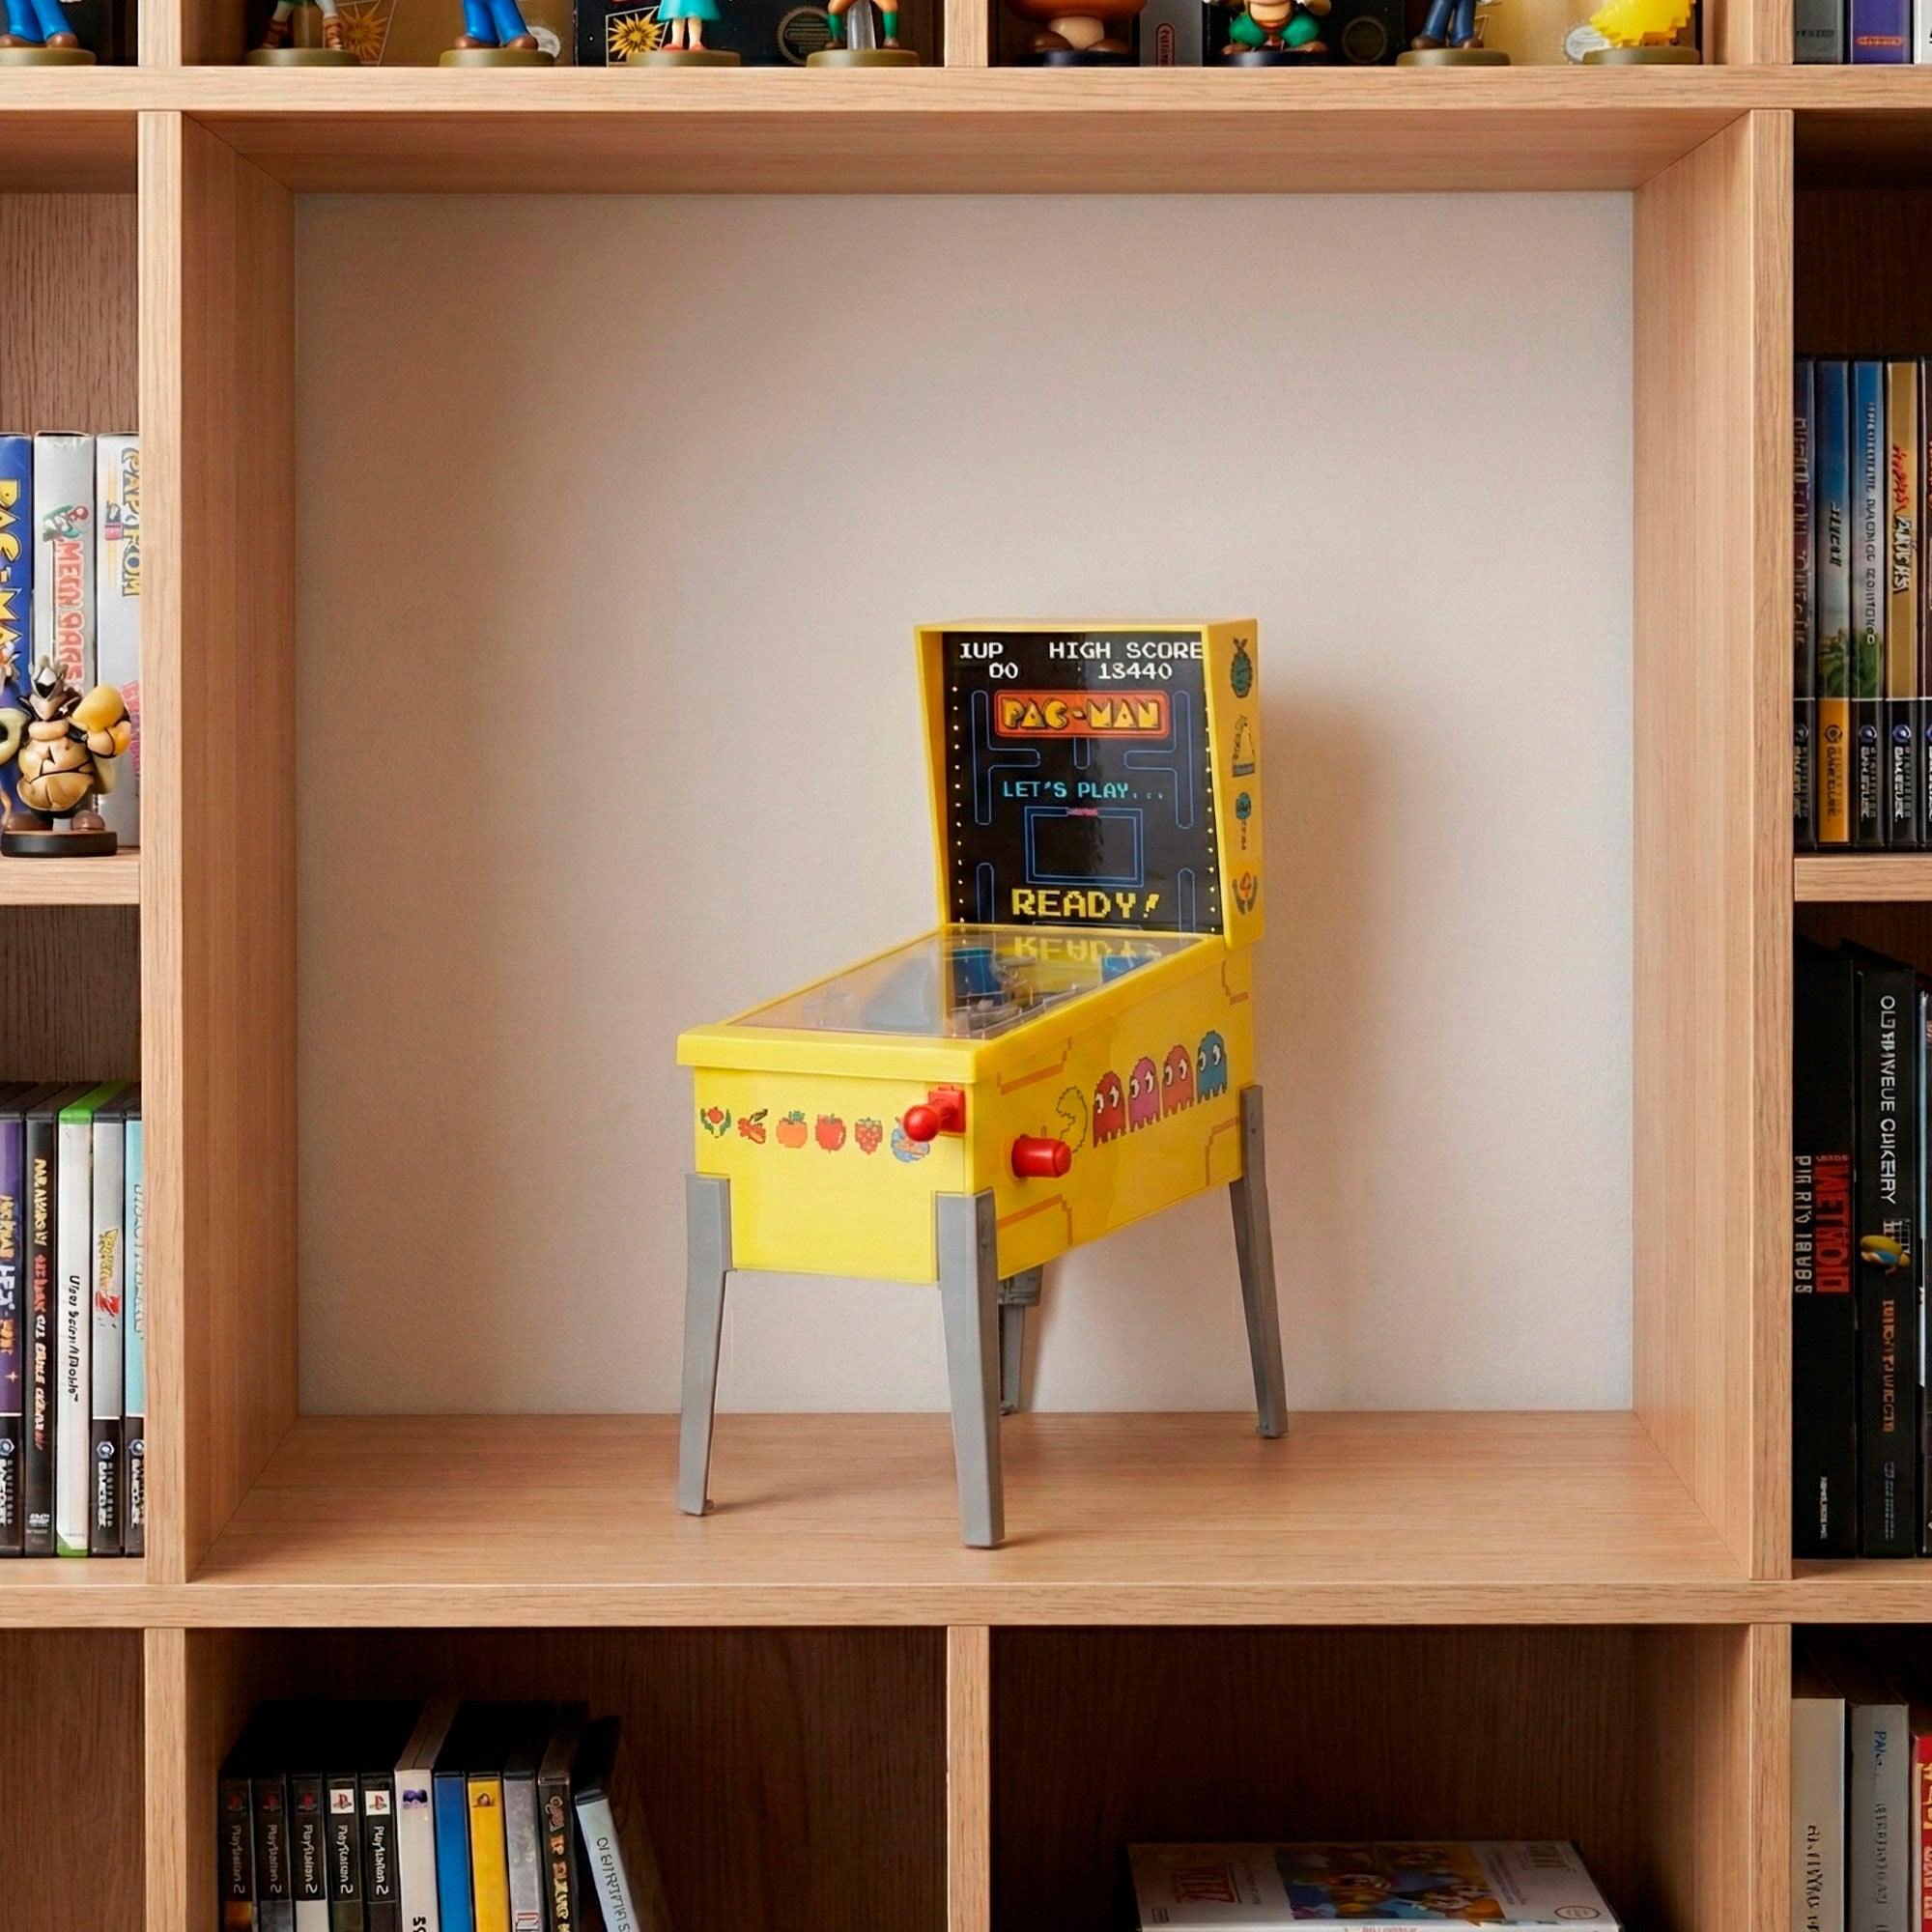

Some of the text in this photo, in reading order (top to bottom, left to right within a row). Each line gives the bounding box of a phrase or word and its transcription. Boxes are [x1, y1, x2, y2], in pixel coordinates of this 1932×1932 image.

[1049, 641, 1204, 660] HIGH SCORE
[1098, 662, 1173, 679] 13440
[1001, 696, 1160, 729] PAC-MAN
[1003, 781, 1067, 798] LET'S
[1011, 889, 1160, 919] READY!
[233, 1884, 245, 1894] 2
[270, 1884, 282, 1894] 2
[305, 1884, 318, 1894] 2
[340, 1884, 354, 1894] 2
[376, 1885, 389, 1895] 2
